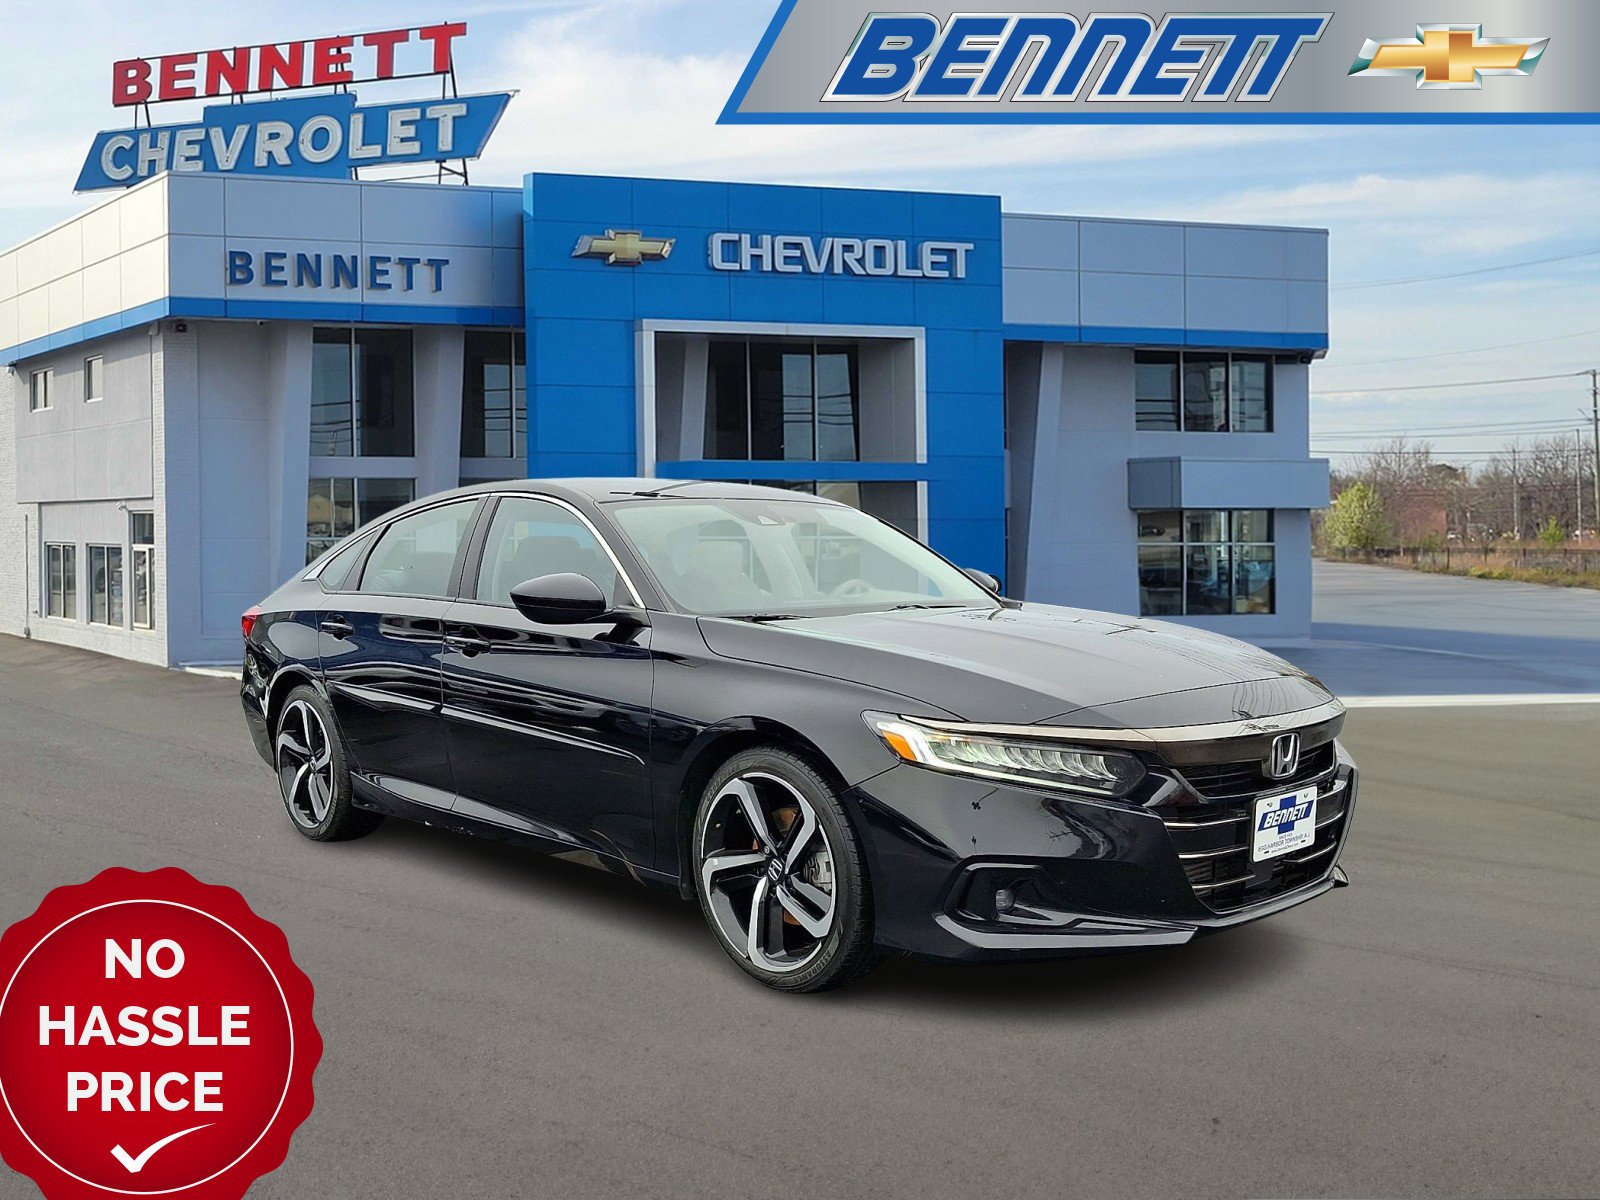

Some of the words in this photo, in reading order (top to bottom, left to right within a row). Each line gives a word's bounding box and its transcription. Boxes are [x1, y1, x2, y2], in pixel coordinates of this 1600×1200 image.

[112, 22, 467, 106] BENNETT
[99, 102, 469, 181] CHEVROLET
[226, 250, 450, 293] BENNETT
[708, 232, 974, 279] CHEVROLET
[1263, 802, 1309, 829] BENNETT
